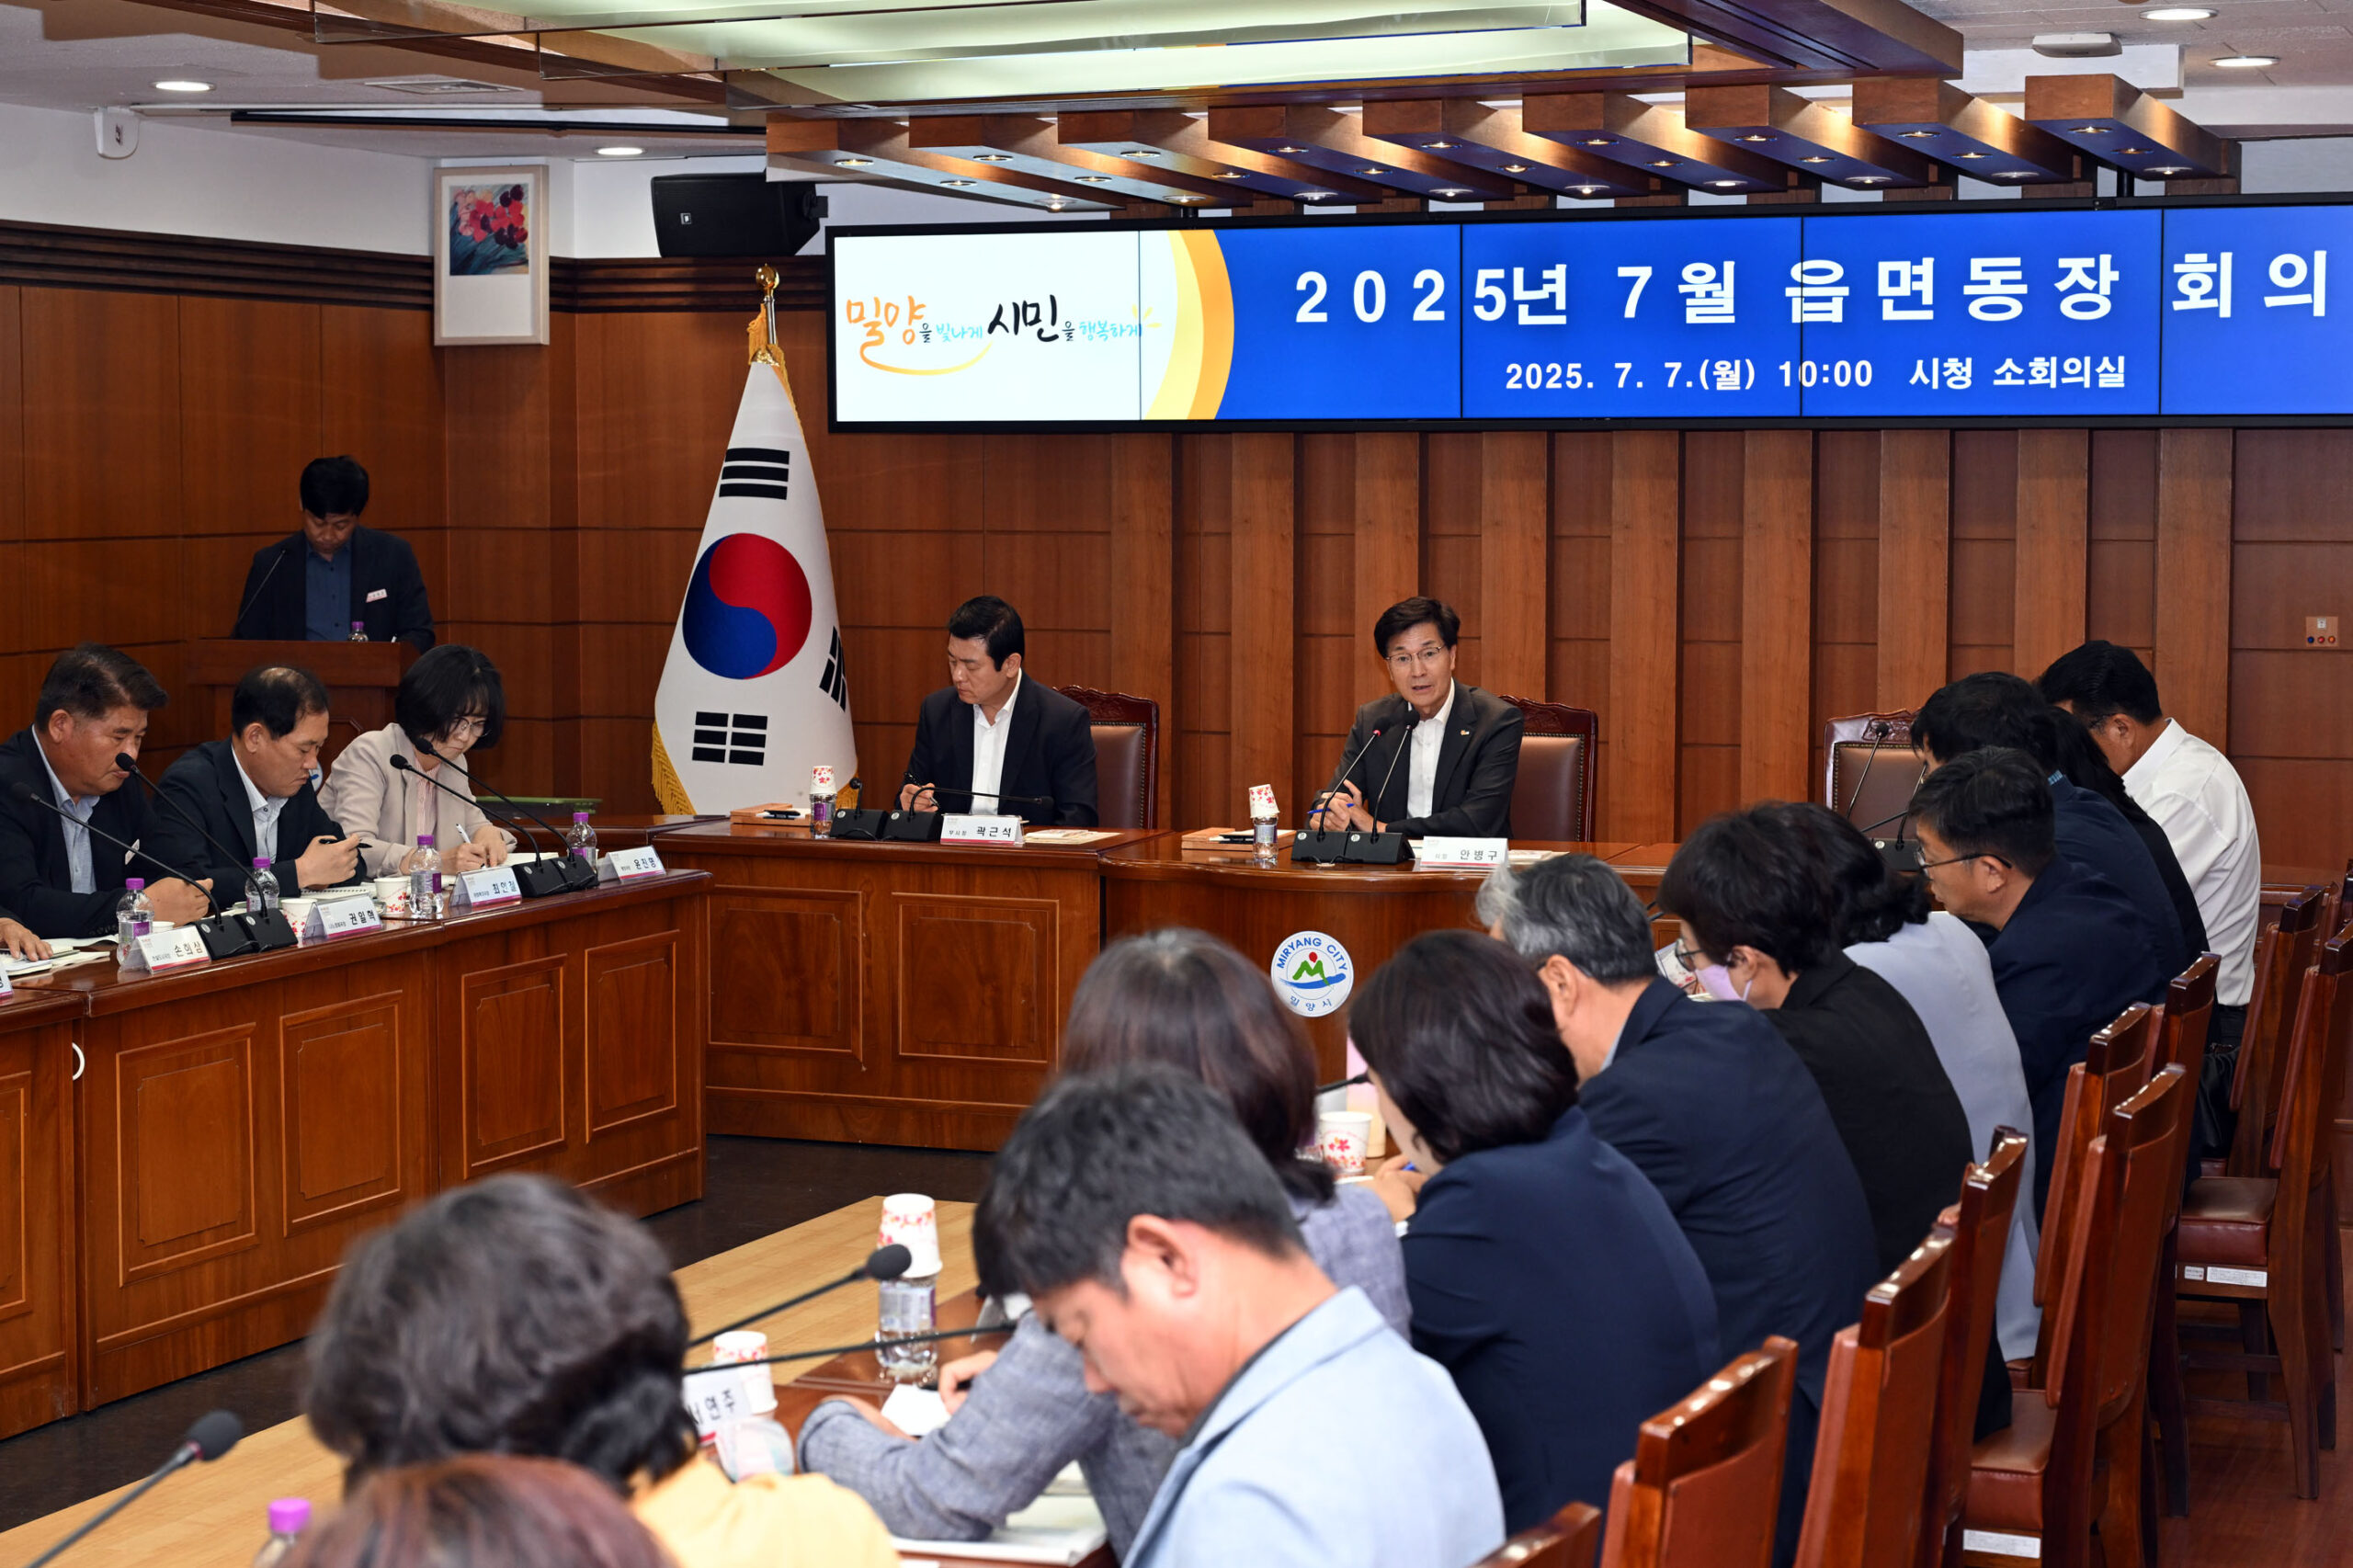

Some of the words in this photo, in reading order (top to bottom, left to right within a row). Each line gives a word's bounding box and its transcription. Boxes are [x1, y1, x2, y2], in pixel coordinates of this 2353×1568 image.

[1296, 264, 1567, 325] 2025년
[1617, 260, 1735, 324] 7월
[1785, 254, 2120, 324] 읍면동장
[2172, 250, 2327, 318] 회의
[1506, 362, 1594, 390] 2025.
[1614, 362, 1643, 389] 7.
[1779, 359, 1872, 388] 10:00
[1909, 357, 1972, 390] 시청
[1993, 356, 2125, 389] 소회의실
[976, 826, 1012, 838] 곽근석
[1460, 849, 1498, 861] 안병구
[1276, 937, 1323, 969] MIRYANG
[1326, 944, 1348, 971] CITY
[1290, 995, 1332, 1012] 밀양시
